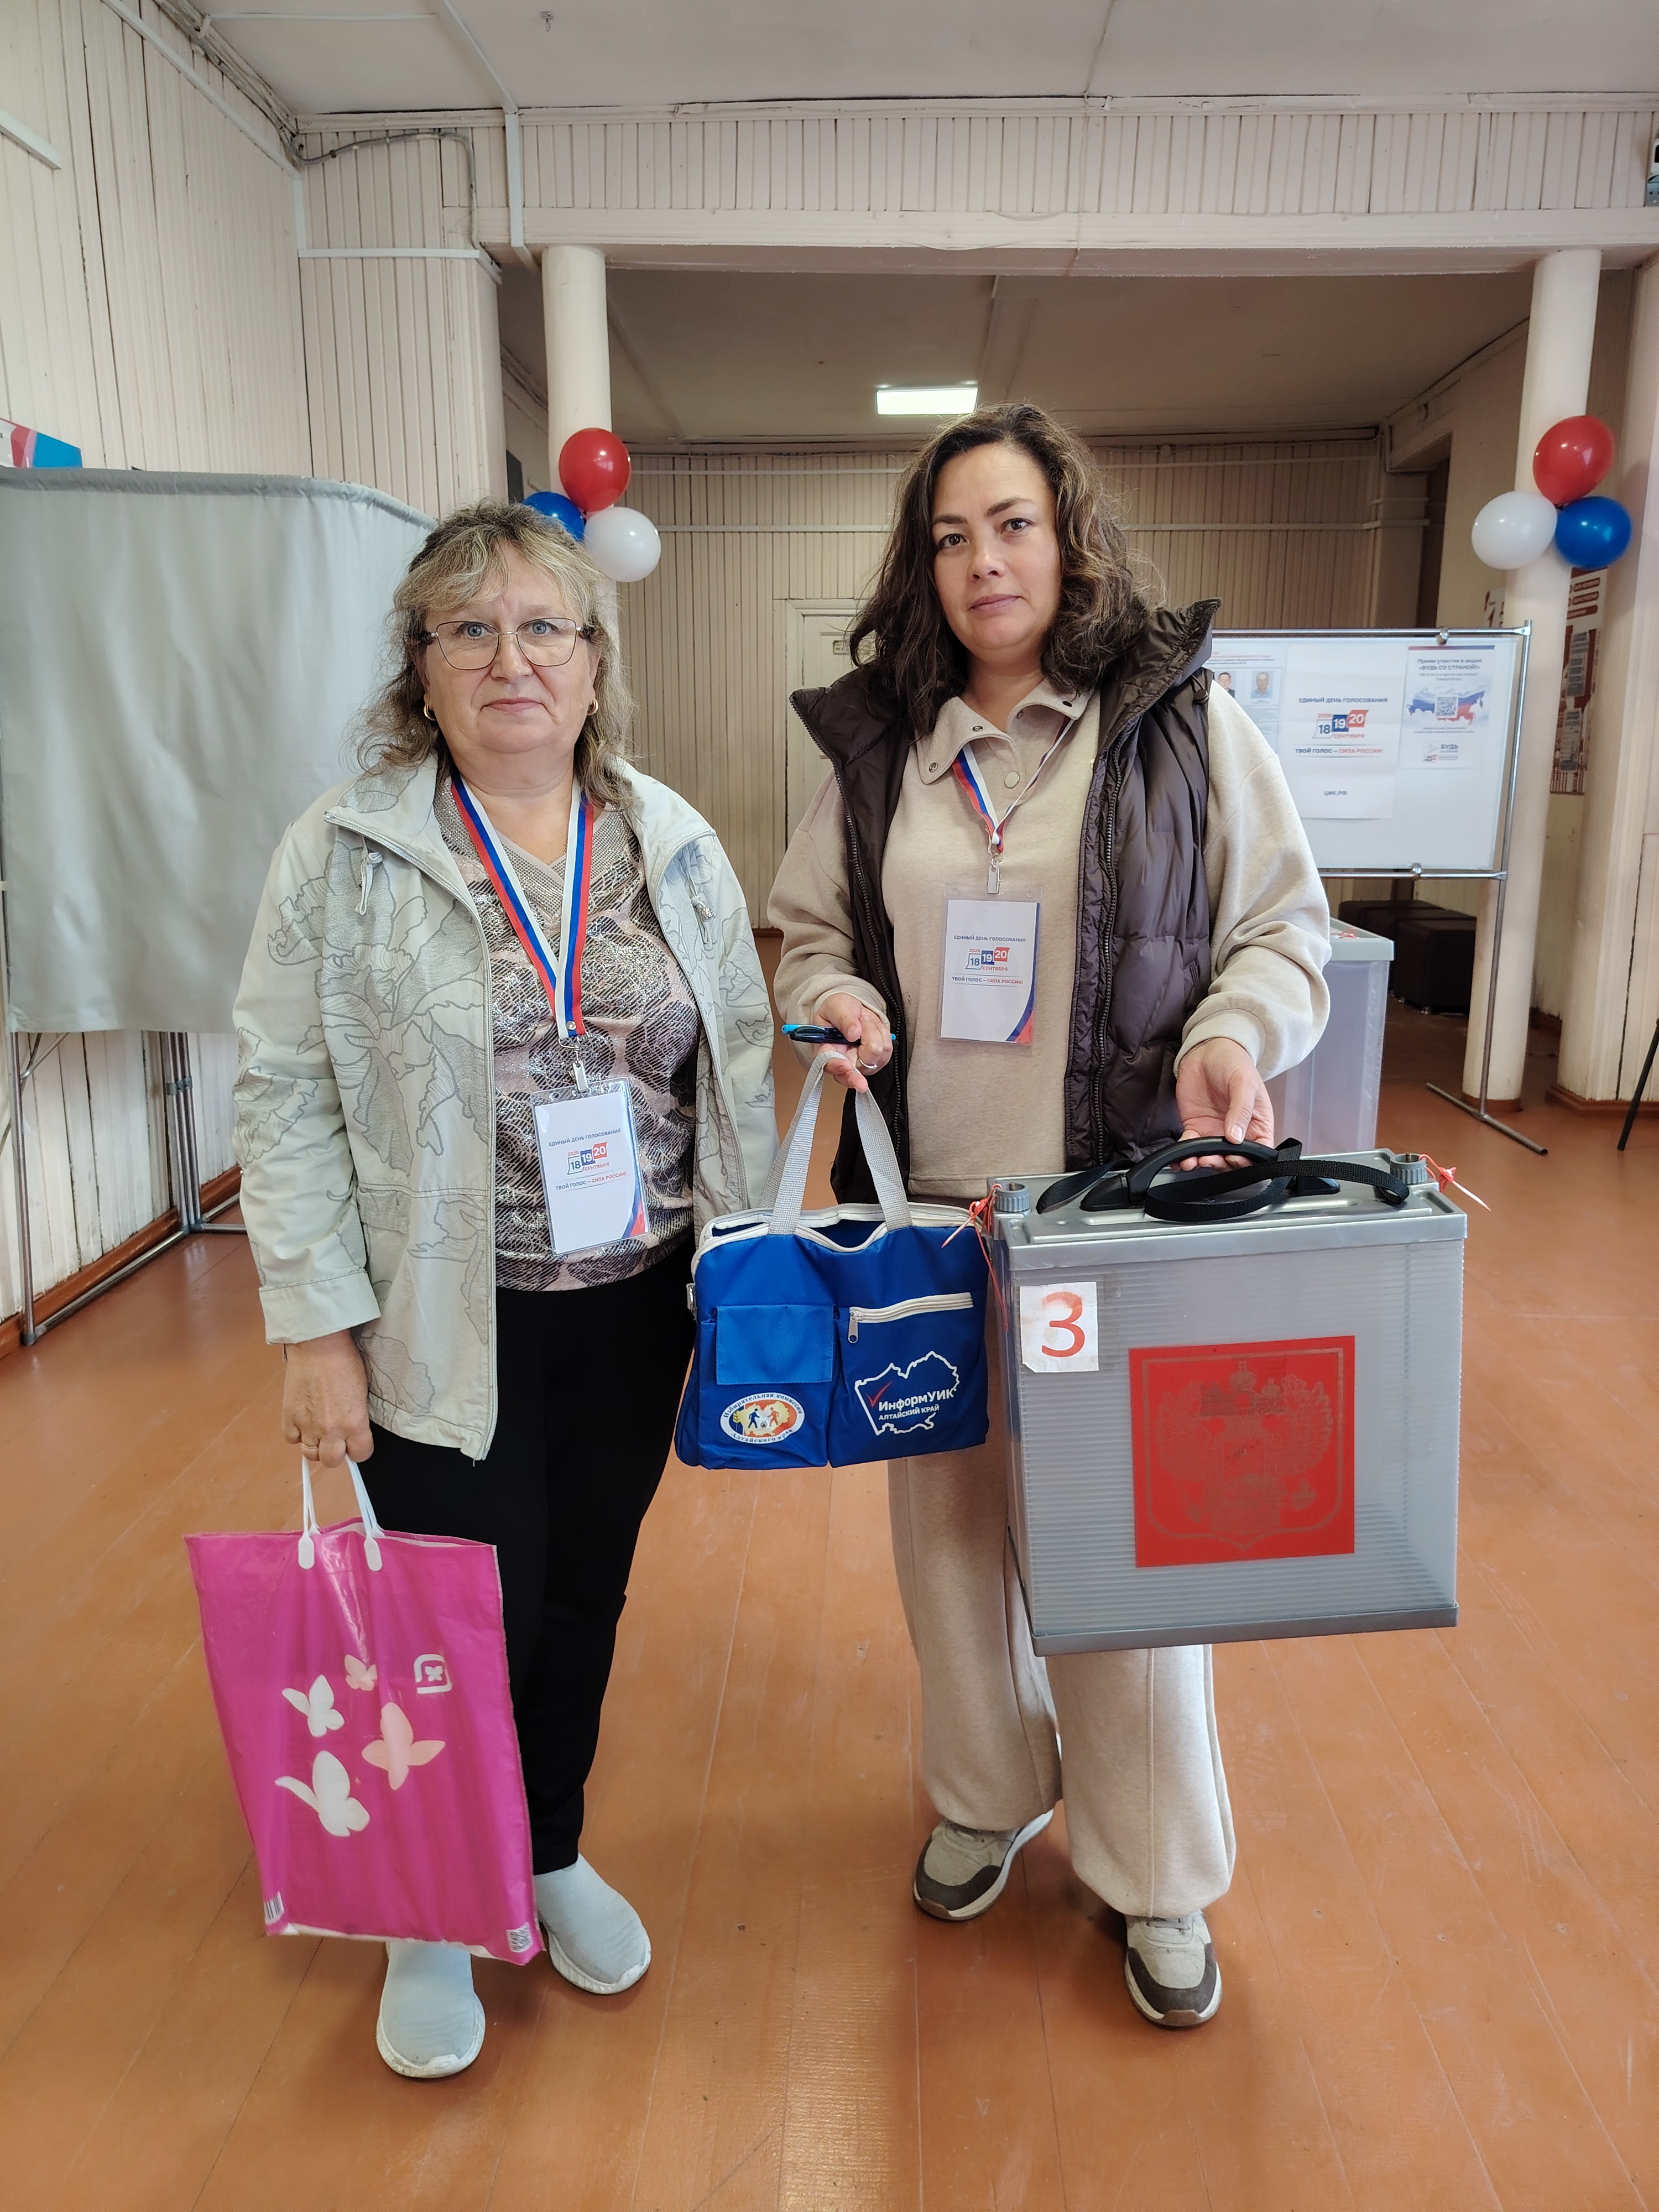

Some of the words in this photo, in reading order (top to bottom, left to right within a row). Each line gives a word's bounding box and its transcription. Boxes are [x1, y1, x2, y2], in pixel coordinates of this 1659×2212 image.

[1318, 724, 1331, 734] 18
[1333, 718, 1346, 729] 19
[1348, 713, 1364, 724] 20
[970, 958, 980, 966] 18
[982, 953, 993, 962] 19
[994, 950, 1007, 959] 20
[549, 1138, 571, 1147] ЕДИНЫЙ
[585, 1128, 621, 1139] ГОЛОСОВАНИЯ
[570, 1160, 581, 1170] 18
[581, 1153, 592, 1163] 19
[593, 1146, 606, 1156] 20
[585, 1162, 609, 1171] СЕНТЯБРЯ
[606, 1172, 627, 1180] РОССИИ!
[1041, 1291, 1085, 1358] 3
[723, 1393, 774, 1418] Избирательная
[776, 1394, 802, 1414] комиссия
[878, 1389, 954, 1411] ИнформУИК
[878, 1407, 920, 1421] АЛТАЙСКИЙ
[921, 1404, 940, 1413] КРАЙ
[731, 1432, 776, 1443] Алтайского
